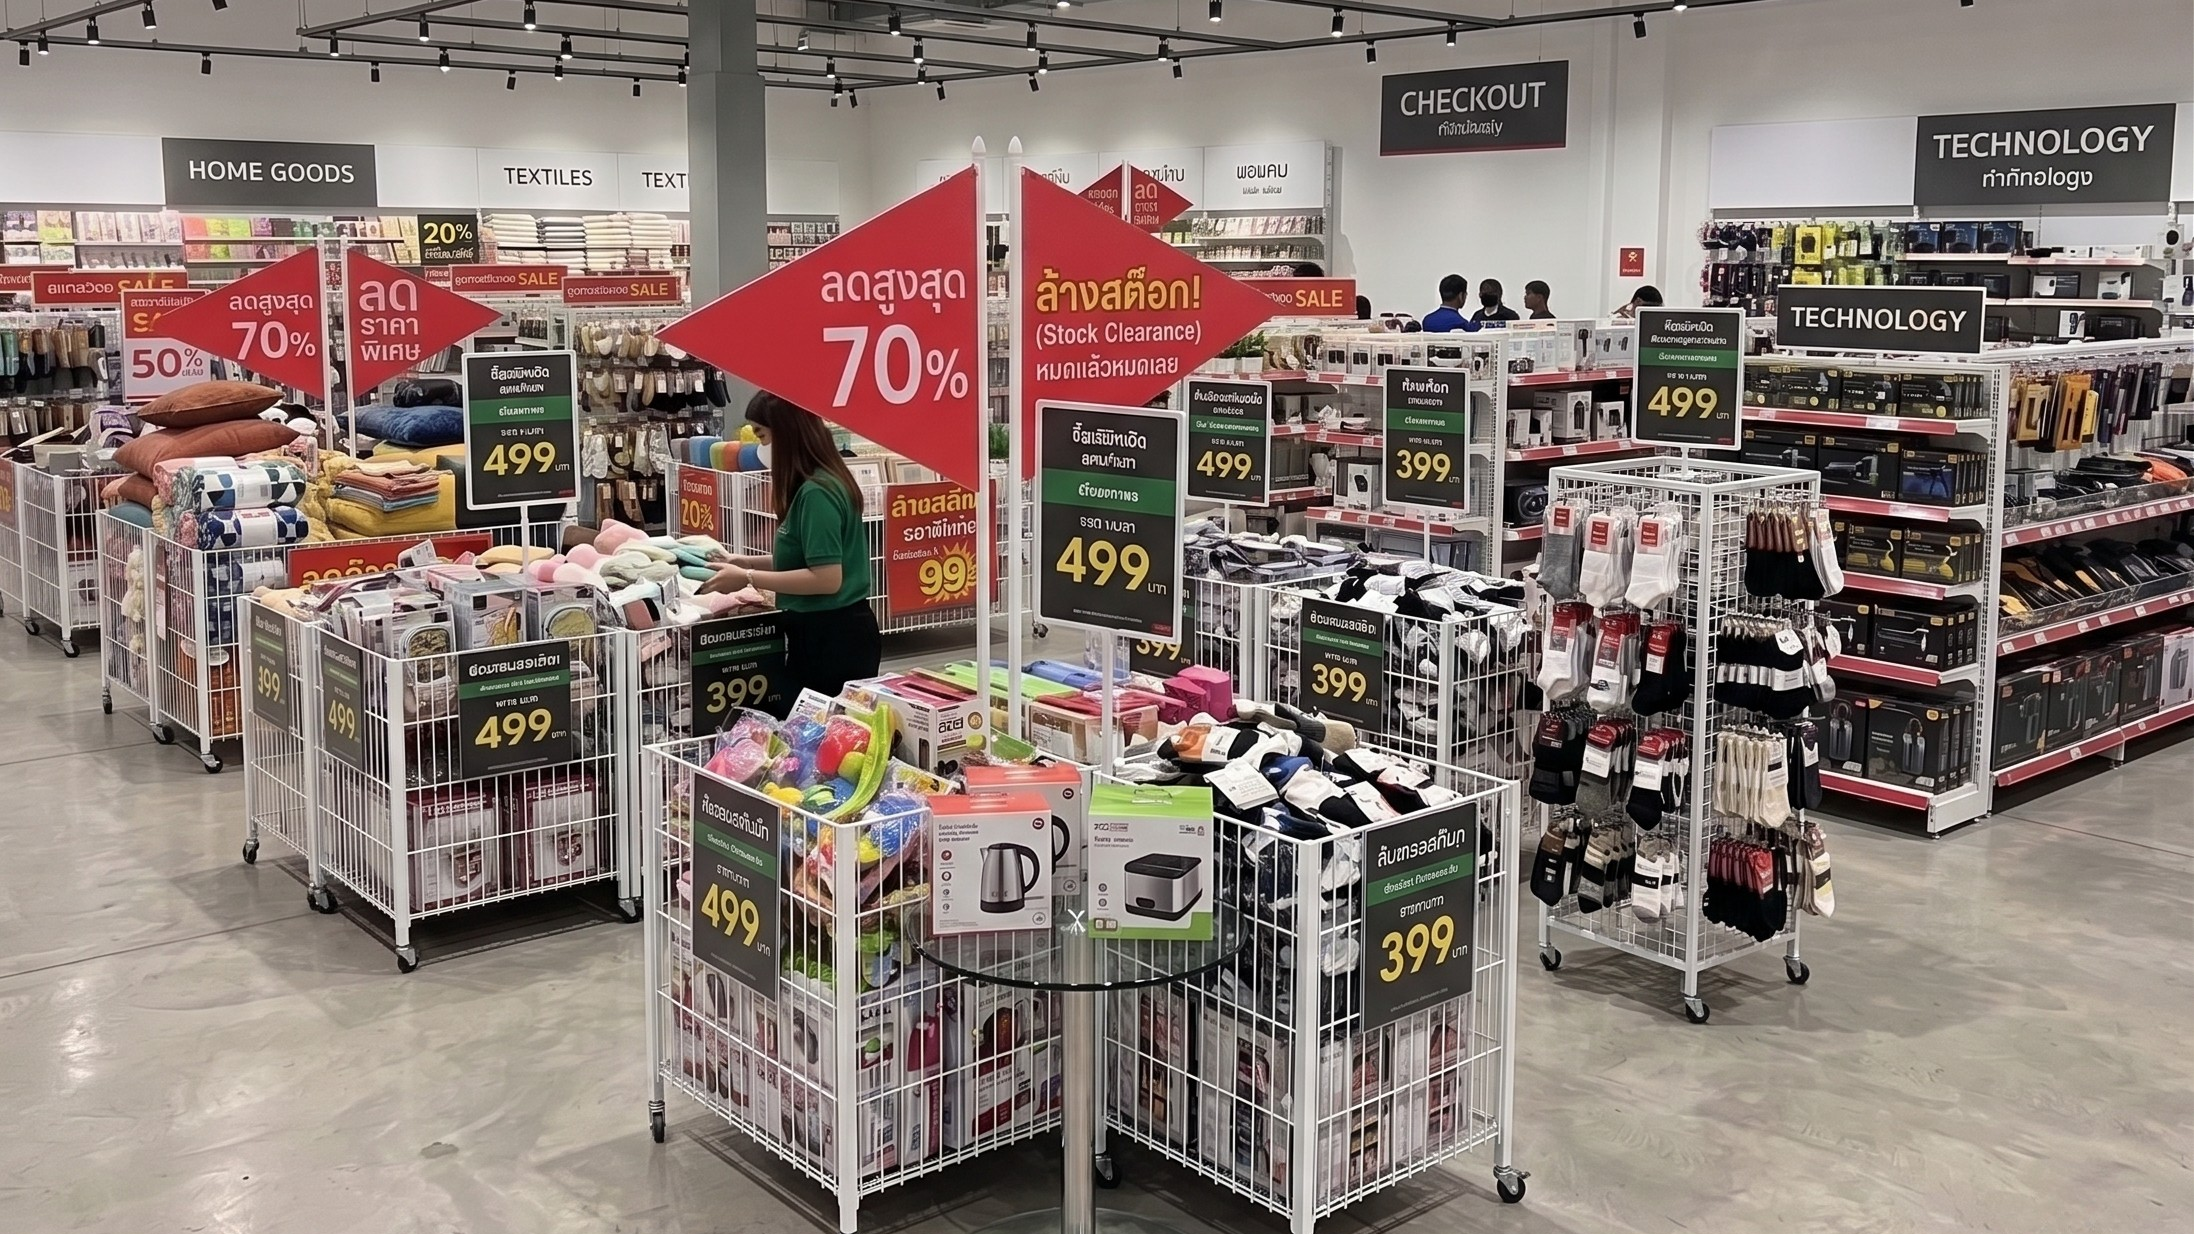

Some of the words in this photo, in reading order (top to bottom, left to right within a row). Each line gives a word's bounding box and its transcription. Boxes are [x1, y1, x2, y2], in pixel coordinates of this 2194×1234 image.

[1400, 81, 1547, 117] CHECKOUT
[1933, 124, 2154, 161] TECHNOLOGY
[189, 160, 263, 182] HOME
[270, 162, 356, 184] GOODS
[503, 166, 593, 187] TEXTILES
[641, 171, 687, 189] TEXT
[423, 221, 473, 245] 20%
[518, 272, 559, 286] SALE
[630, 283, 669, 297] SALE
[821, 267, 967, 316] ลดสูงสุด
[229, 293, 314, 319] ลดสูงสุด
[359, 281, 419, 315] ลด
[1295, 289, 1344, 308] SALE
[359, 313, 420, 337] ราคา
[1036, 322, 1099, 350] (Stock
[1104, 320, 1202, 348] Clearance)
[1790, 306, 1968, 333] TECHNOLOGY
[231, 320, 317, 362] 70%
[359, 339, 421, 363] พิเศษ
[131, 347, 203, 379] 50%
[821, 323, 970, 409] 70%
[1036, 354, 1179, 381] หมดแล้วหมดเลย
[1647, 386, 1718, 419] 499
[483, 441, 556, 476] 499
[1196, 449, 1253, 481] 499
[1395, 448, 1451, 483] 399
[1056, 536, 1151, 591] 499
[257, 665, 281, 703] 399
[705, 674, 768, 714] 399
[1311, 663, 1367, 702] 399
[328, 699, 356, 740] 499
[475, 707, 552, 749] 499
[701, 882, 760, 948] 499
[1379, 915, 1455, 983] 399
